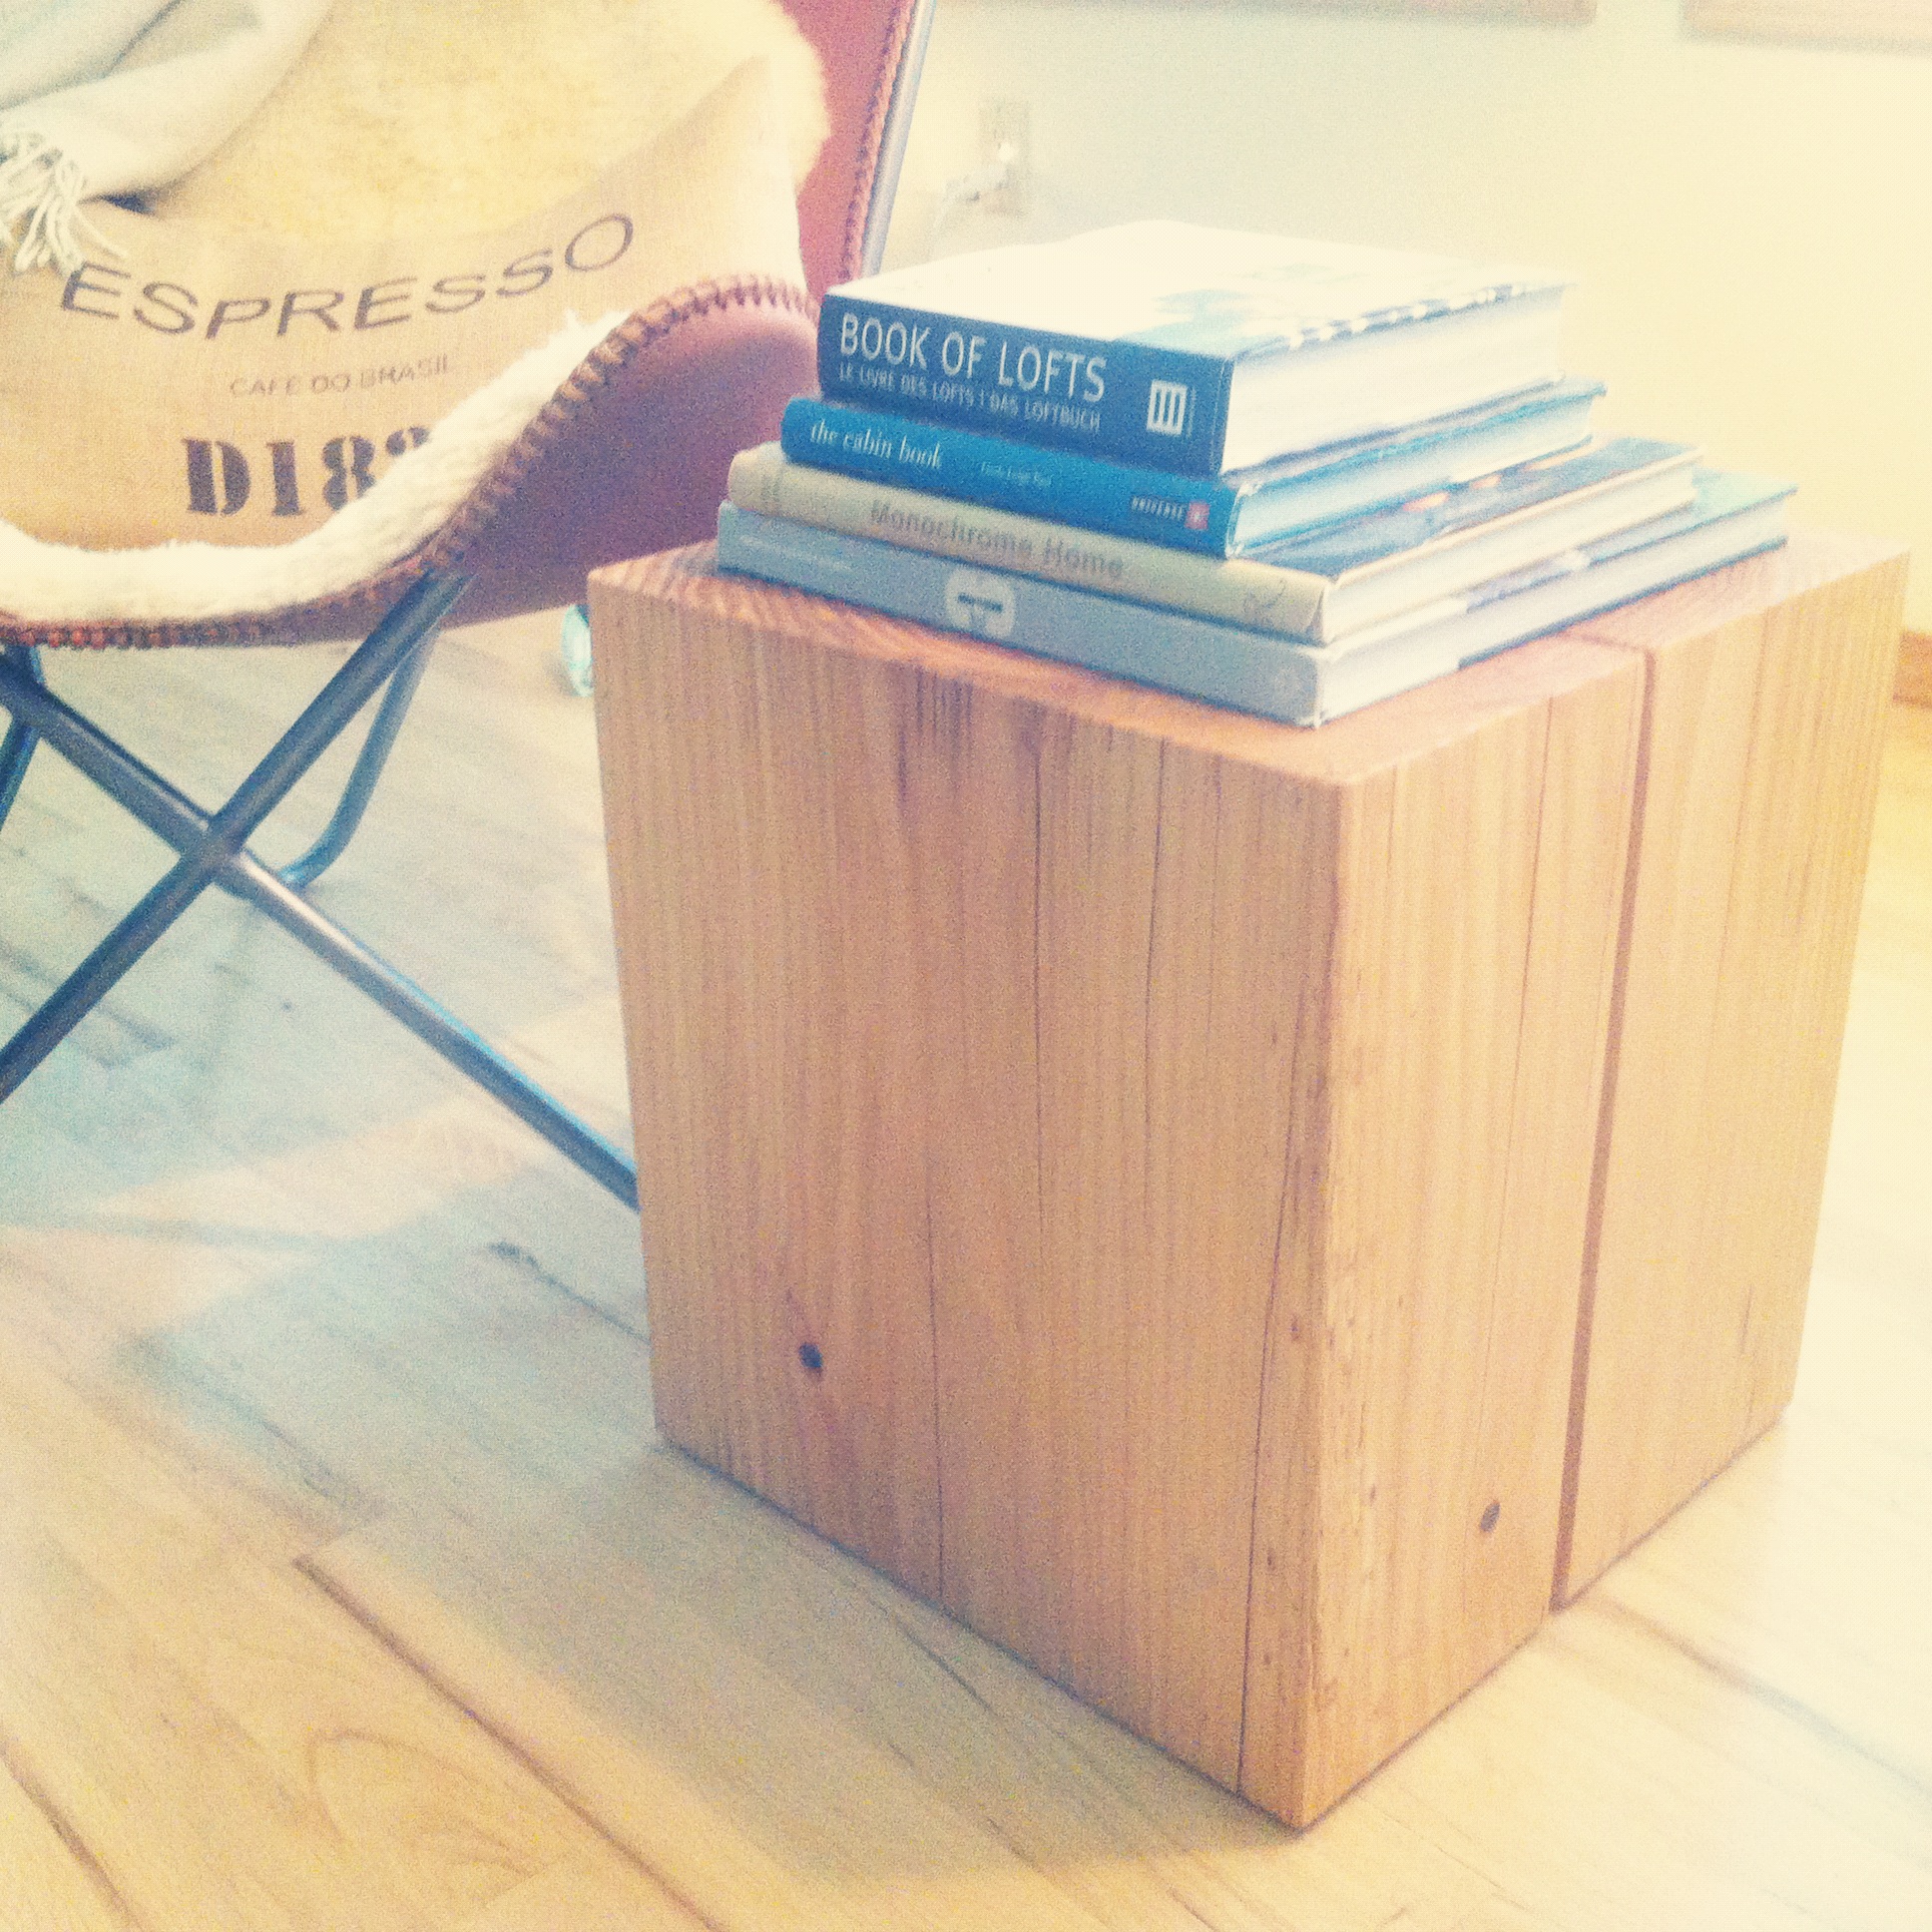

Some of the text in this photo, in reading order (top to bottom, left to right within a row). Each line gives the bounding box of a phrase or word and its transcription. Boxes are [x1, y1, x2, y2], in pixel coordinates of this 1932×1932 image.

[61, 214, 635, 339] ESPRESSO
[311, 373, 350, 394] DO
[841, 312, 1107, 402] BOOK OF LOFTS
[839, 361, 1100, 432] LE LIVRE DES LOFTS DAS LOFTBUCH
[810, 419, 941, 469] the cabin book
[871, 500, 1033, 560] Monochrome
[1045, 536, 1124, 578] Home
